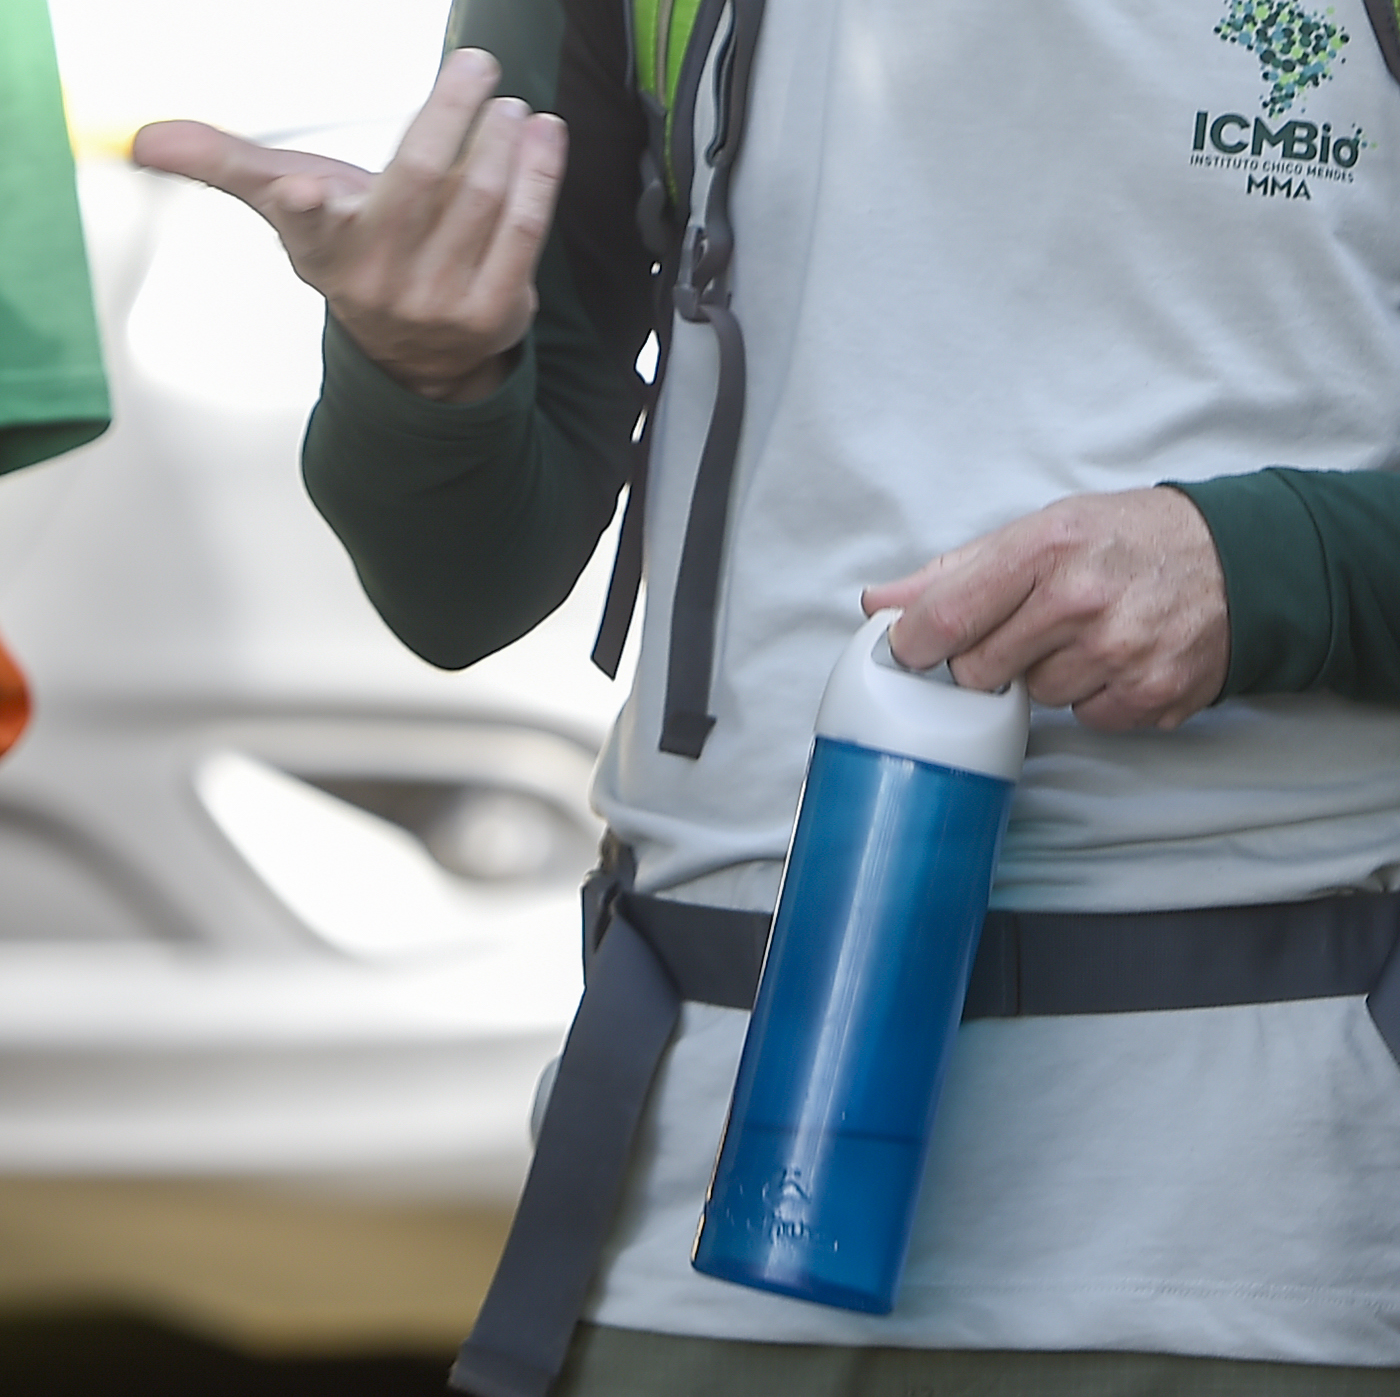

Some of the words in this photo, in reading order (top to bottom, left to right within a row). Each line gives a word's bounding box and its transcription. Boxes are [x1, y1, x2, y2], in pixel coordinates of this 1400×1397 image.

[1192, 110, 1360, 169] ICMBio
[1190, 154, 1258, 171] INSTITUTO
[1262, 160, 1302, 175] CHICO
[1306, 165, 1354, 184] MENDES
[1246, 174, 1311, 200] MMA
